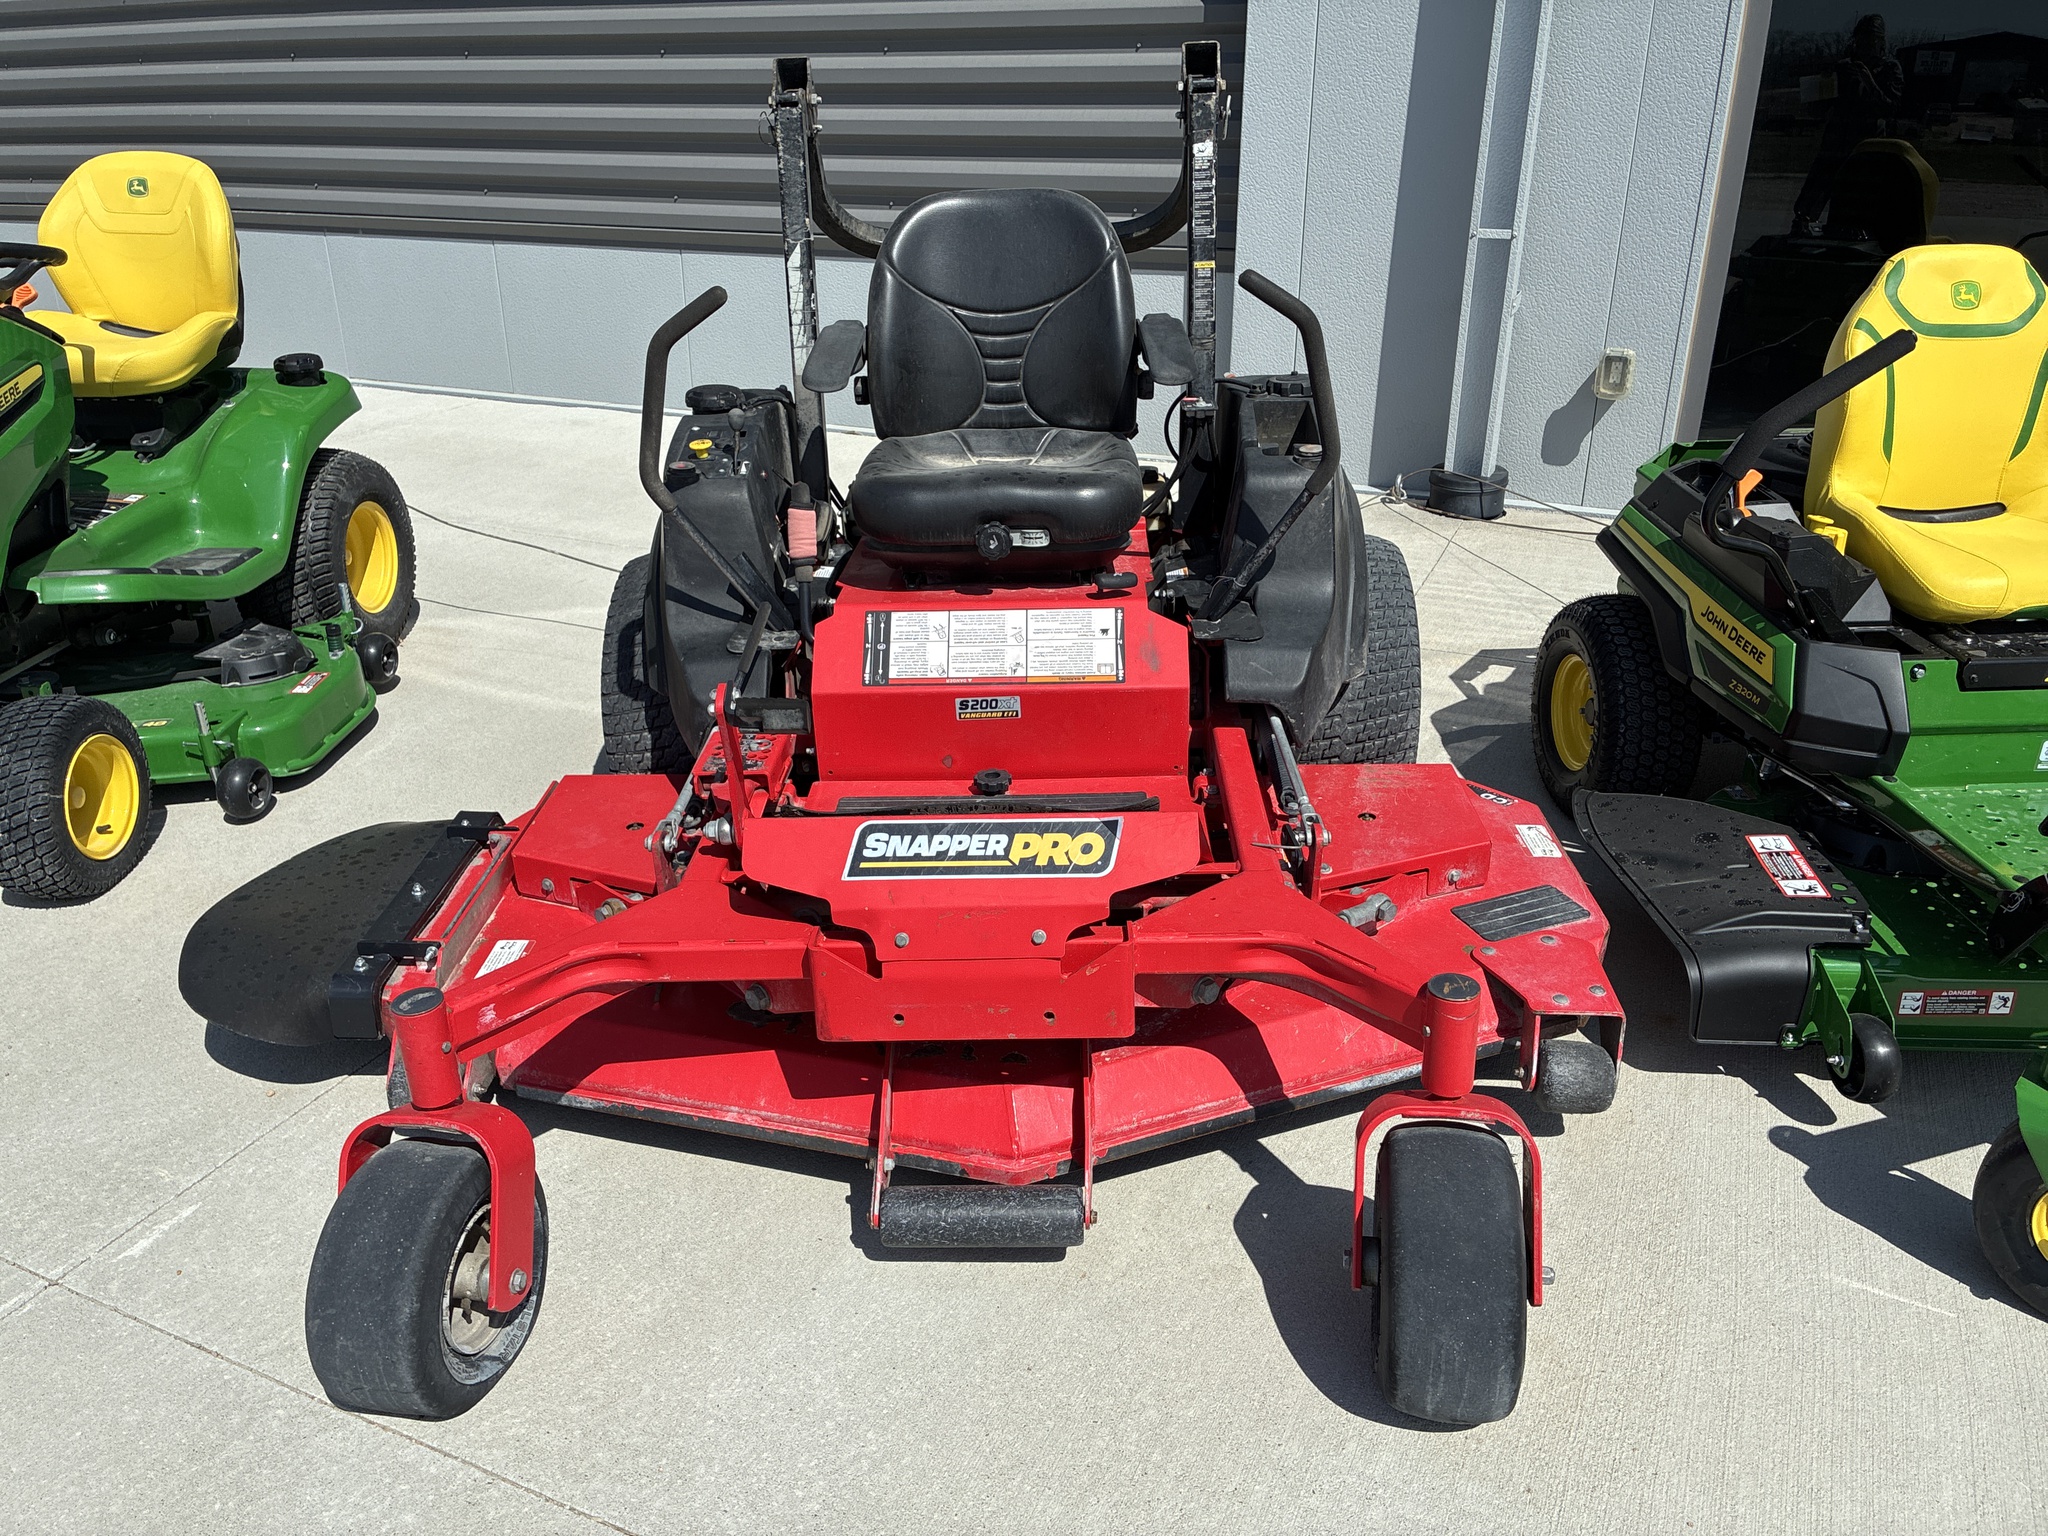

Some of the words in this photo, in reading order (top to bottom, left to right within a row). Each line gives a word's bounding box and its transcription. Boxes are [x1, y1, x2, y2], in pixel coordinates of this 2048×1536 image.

[1700, 605, 1729, 635] JOHN
[1728, 625, 1766, 665] DEERE
[1728, 679, 1761, 705] Z320M
[862, 832, 1009, 858] SNAPPER
[1008, 831, 1106, 866] PRO
[1795, 858, 1815, 878] DANGER
